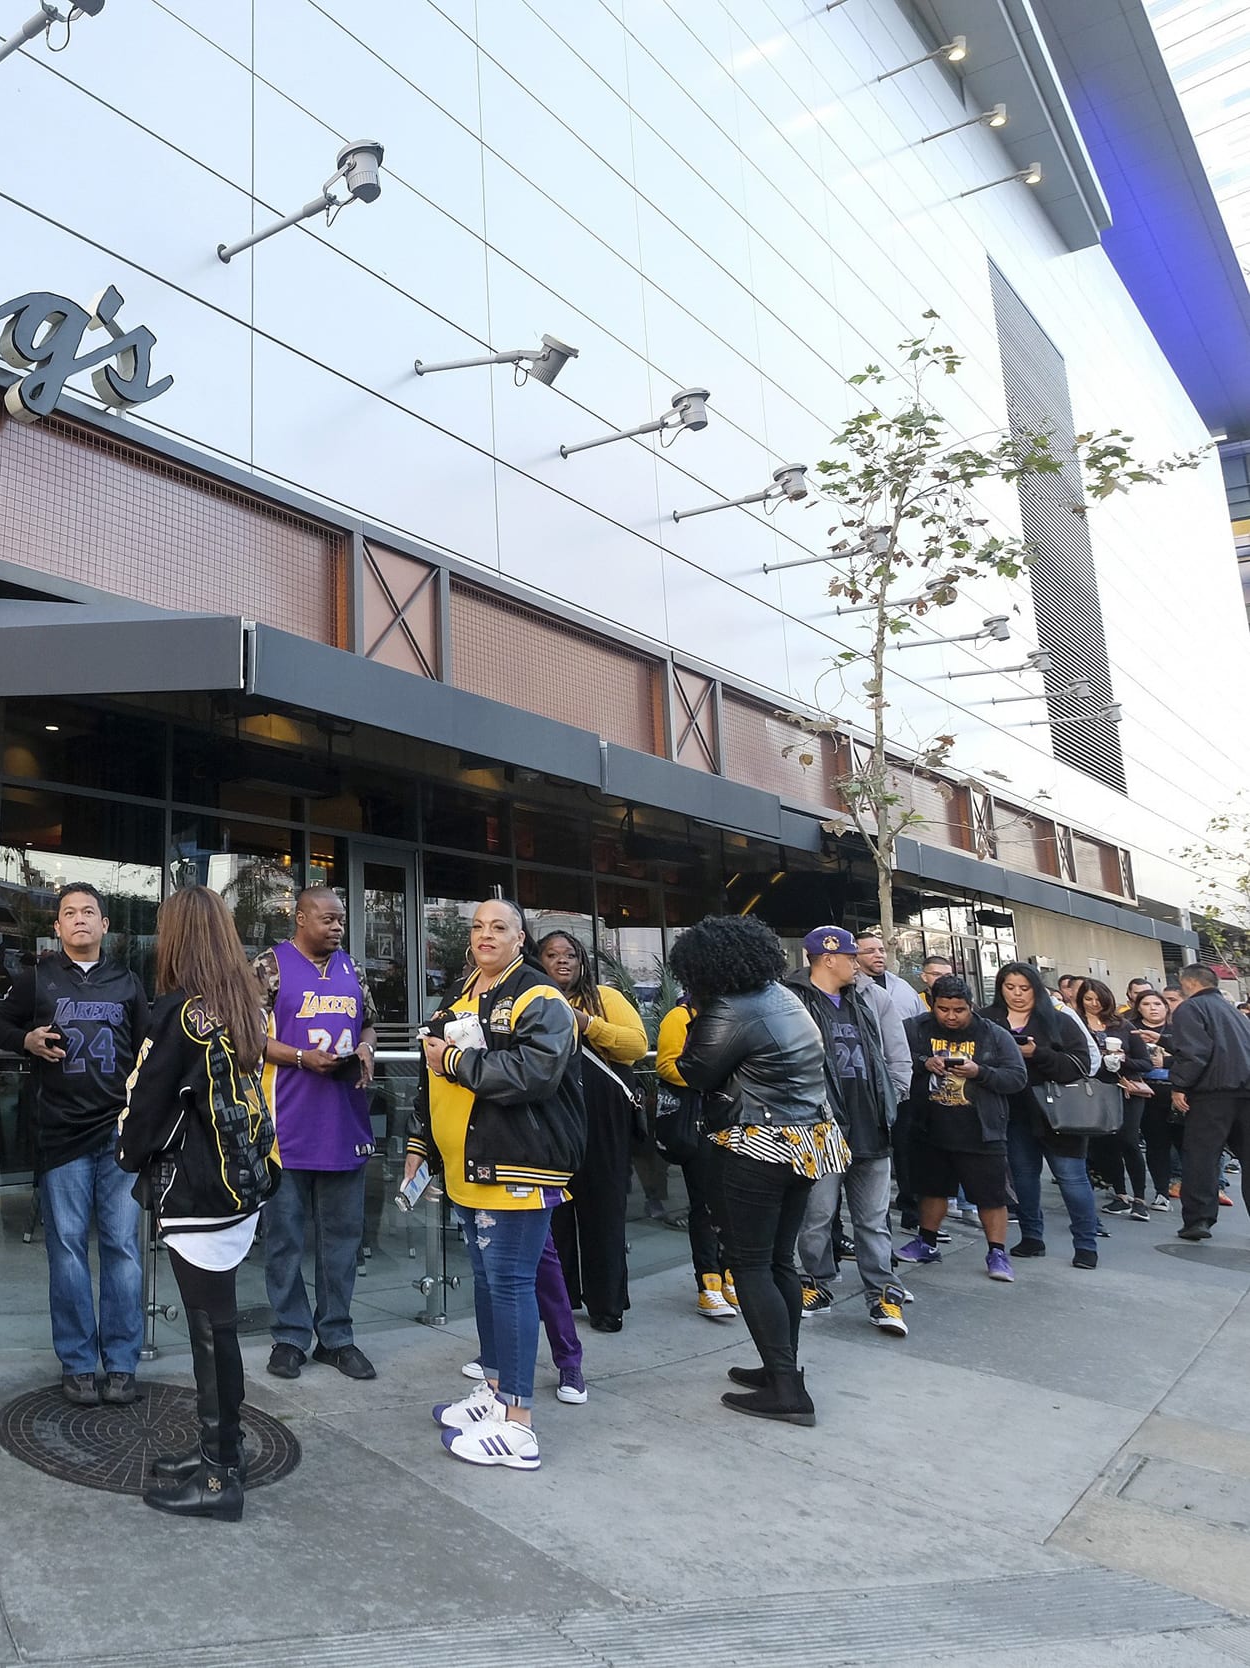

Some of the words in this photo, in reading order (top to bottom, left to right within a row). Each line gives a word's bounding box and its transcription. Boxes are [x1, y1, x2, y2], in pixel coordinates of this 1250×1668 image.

[52, 996, 124, 1027] LAKERS
[295, 991, 357, 1019] LAKERS
[63, 1027, 116, 1074] 24
[307, 1028, 354, 1058] 24
[834, 1042, 868, 1081] 24
